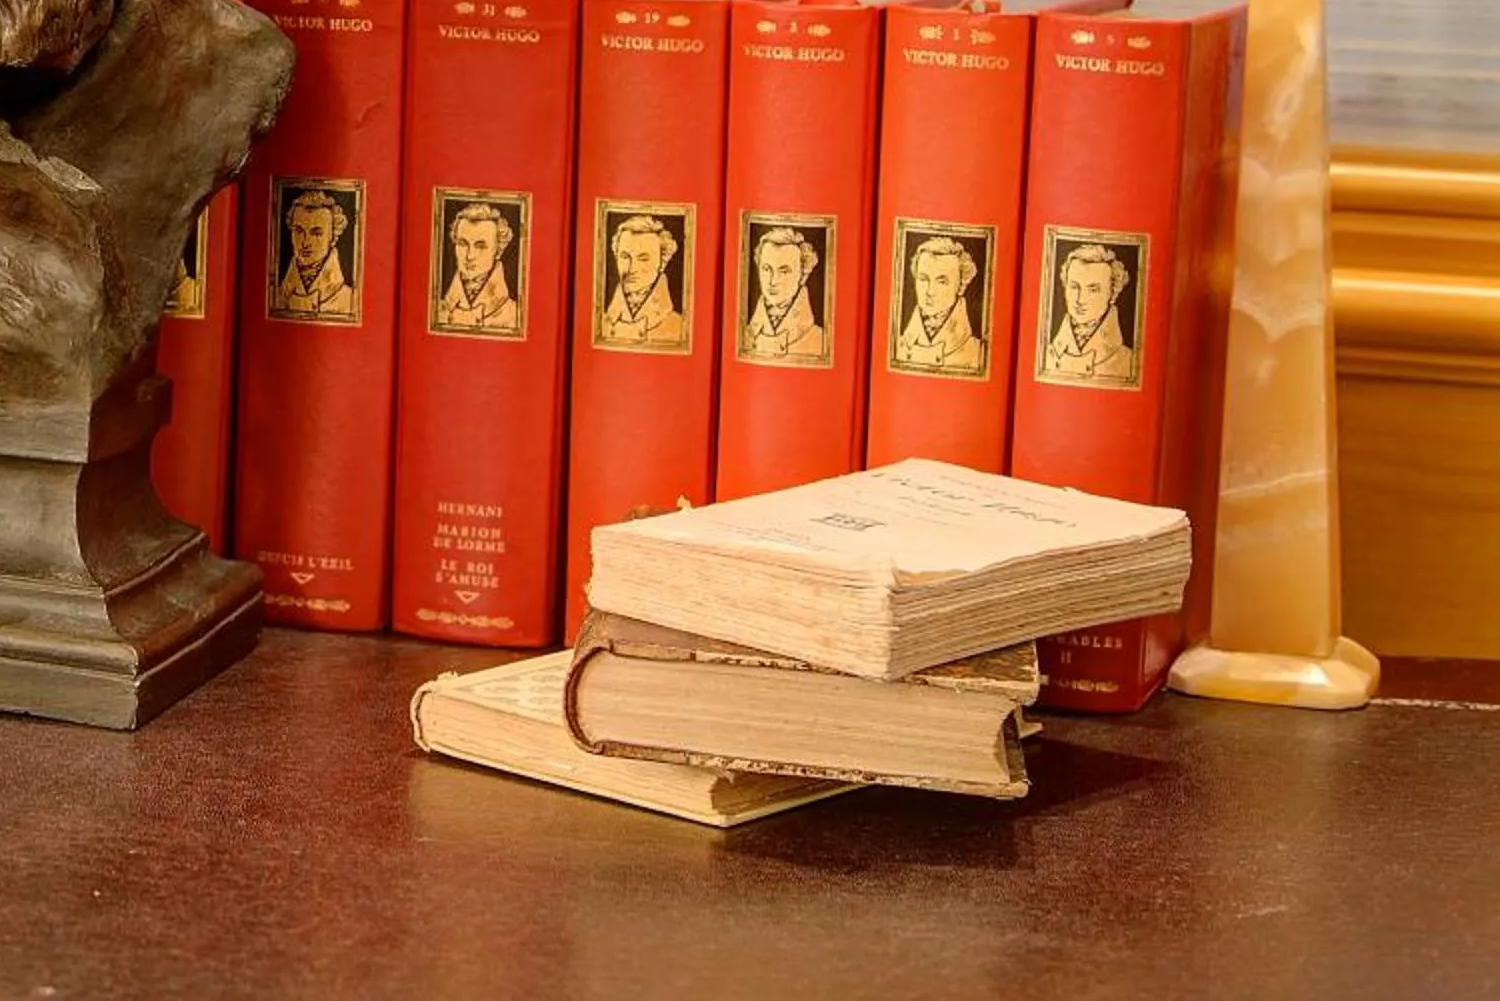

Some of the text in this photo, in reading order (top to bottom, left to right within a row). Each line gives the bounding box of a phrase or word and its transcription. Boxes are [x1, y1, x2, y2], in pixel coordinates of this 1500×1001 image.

[273, 14, 374, 32] VICTOR HUGO
[438, 24, 541, 43] VICTOR HUGO
[602, 34, 705, 53] VICTOR HUGO
[797, 46, 846, 62] HUGO
[902, 48, 1010, 70] VICTOR HUGO
[1055, 53, 1166, 76] VICTOR HUGO
[437, 501, 503, 518] HERNANI
[436, 522, 501, 539] MARION
[456, 538, 506, 553] LORME
[441, 558, 494, 576] LE ROI
[435, 570, 500, 589] S'AMUSE
[1047, 635, 1124, 649] RABLES
